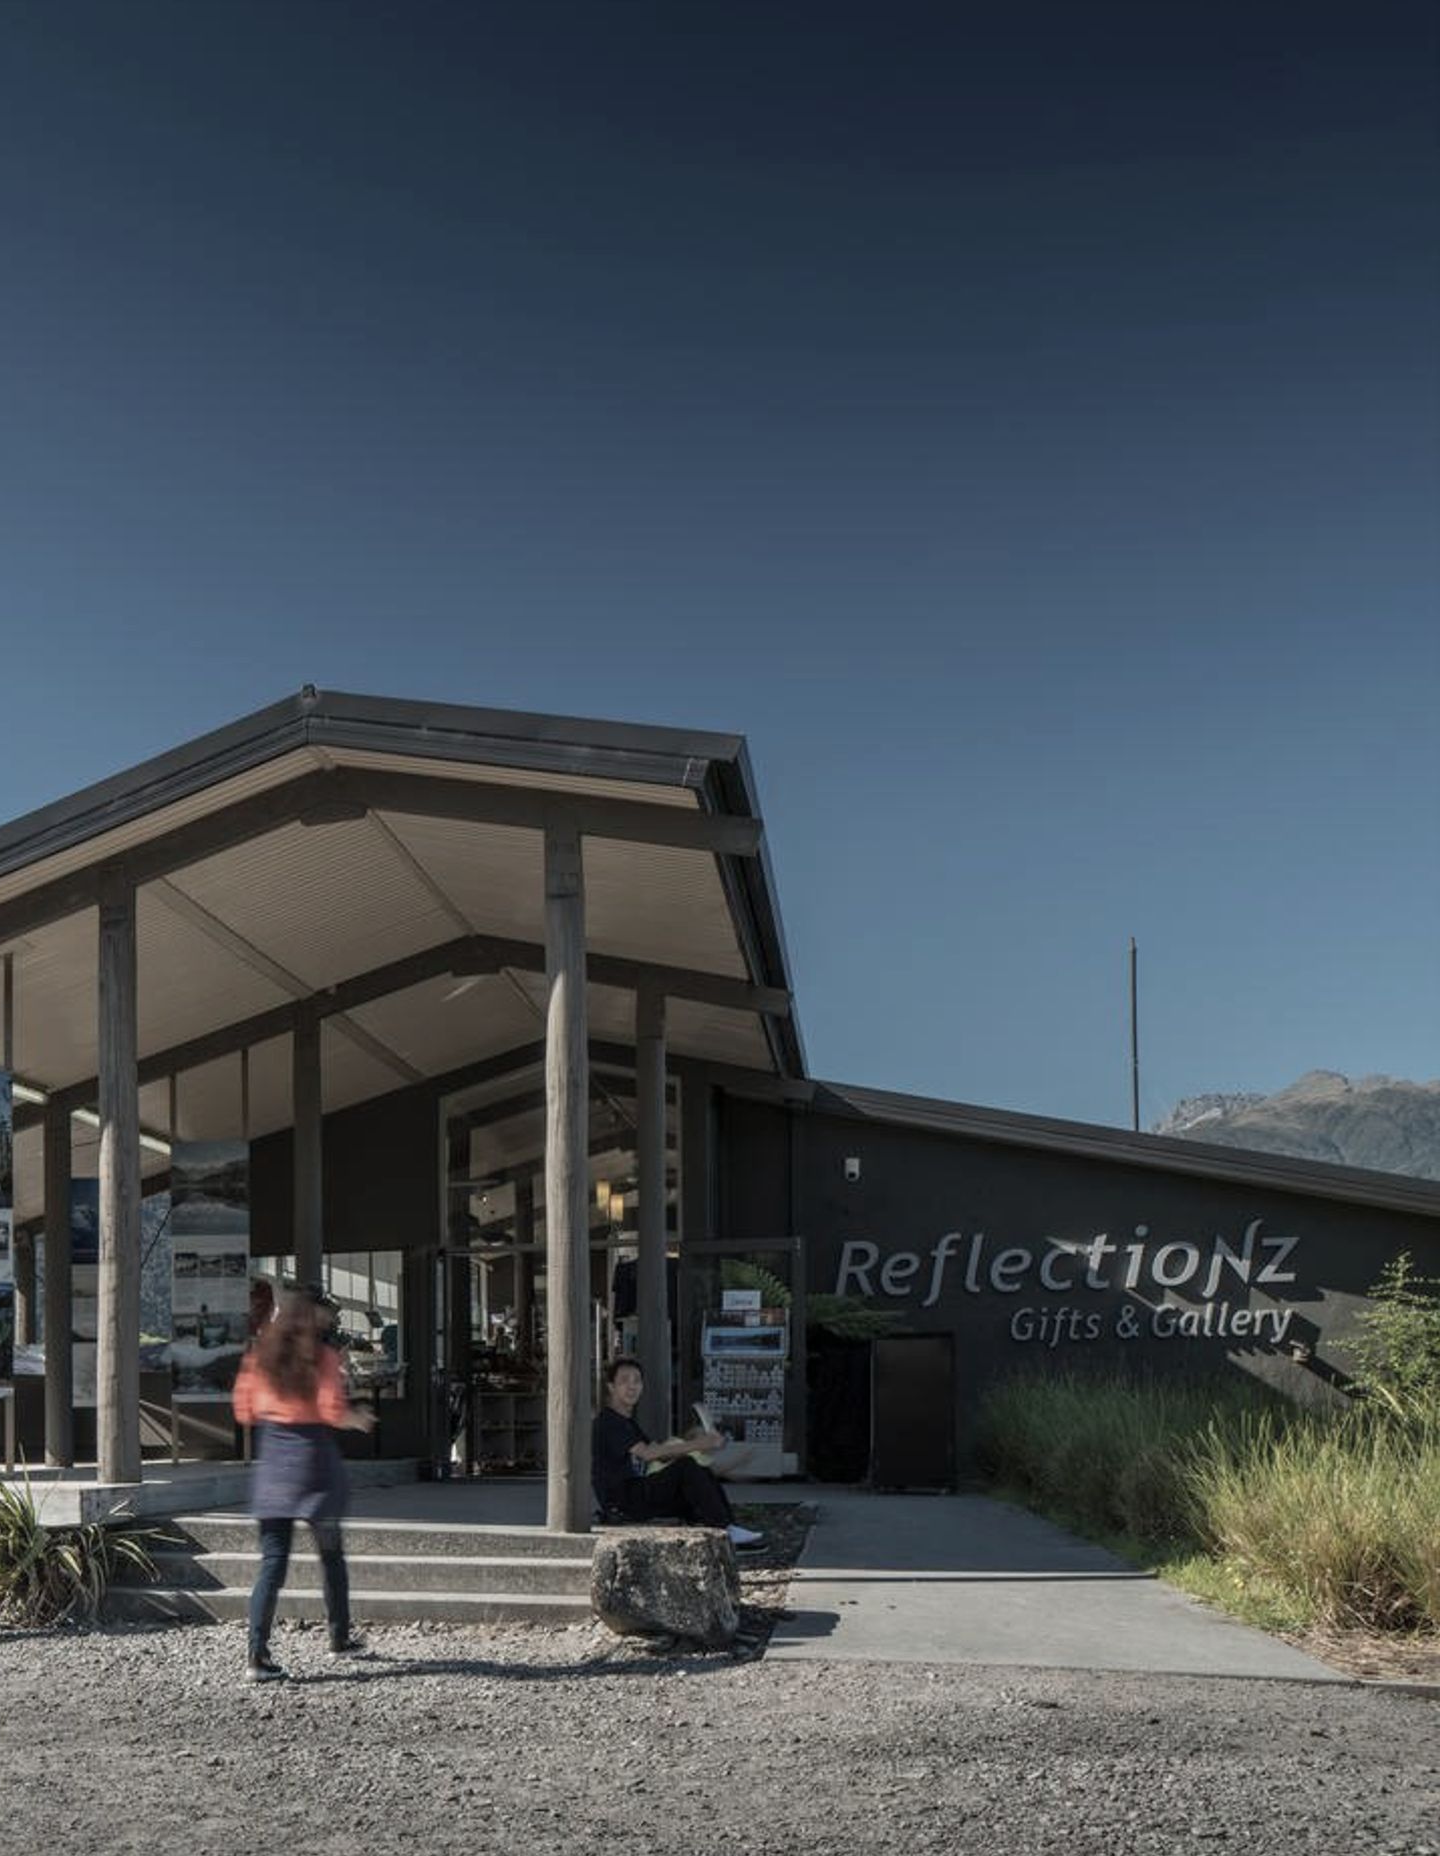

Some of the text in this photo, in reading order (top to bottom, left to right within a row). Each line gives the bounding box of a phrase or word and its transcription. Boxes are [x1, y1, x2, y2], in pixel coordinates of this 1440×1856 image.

[1011, 1301, 1292, 1347] Gifts & Gallery
